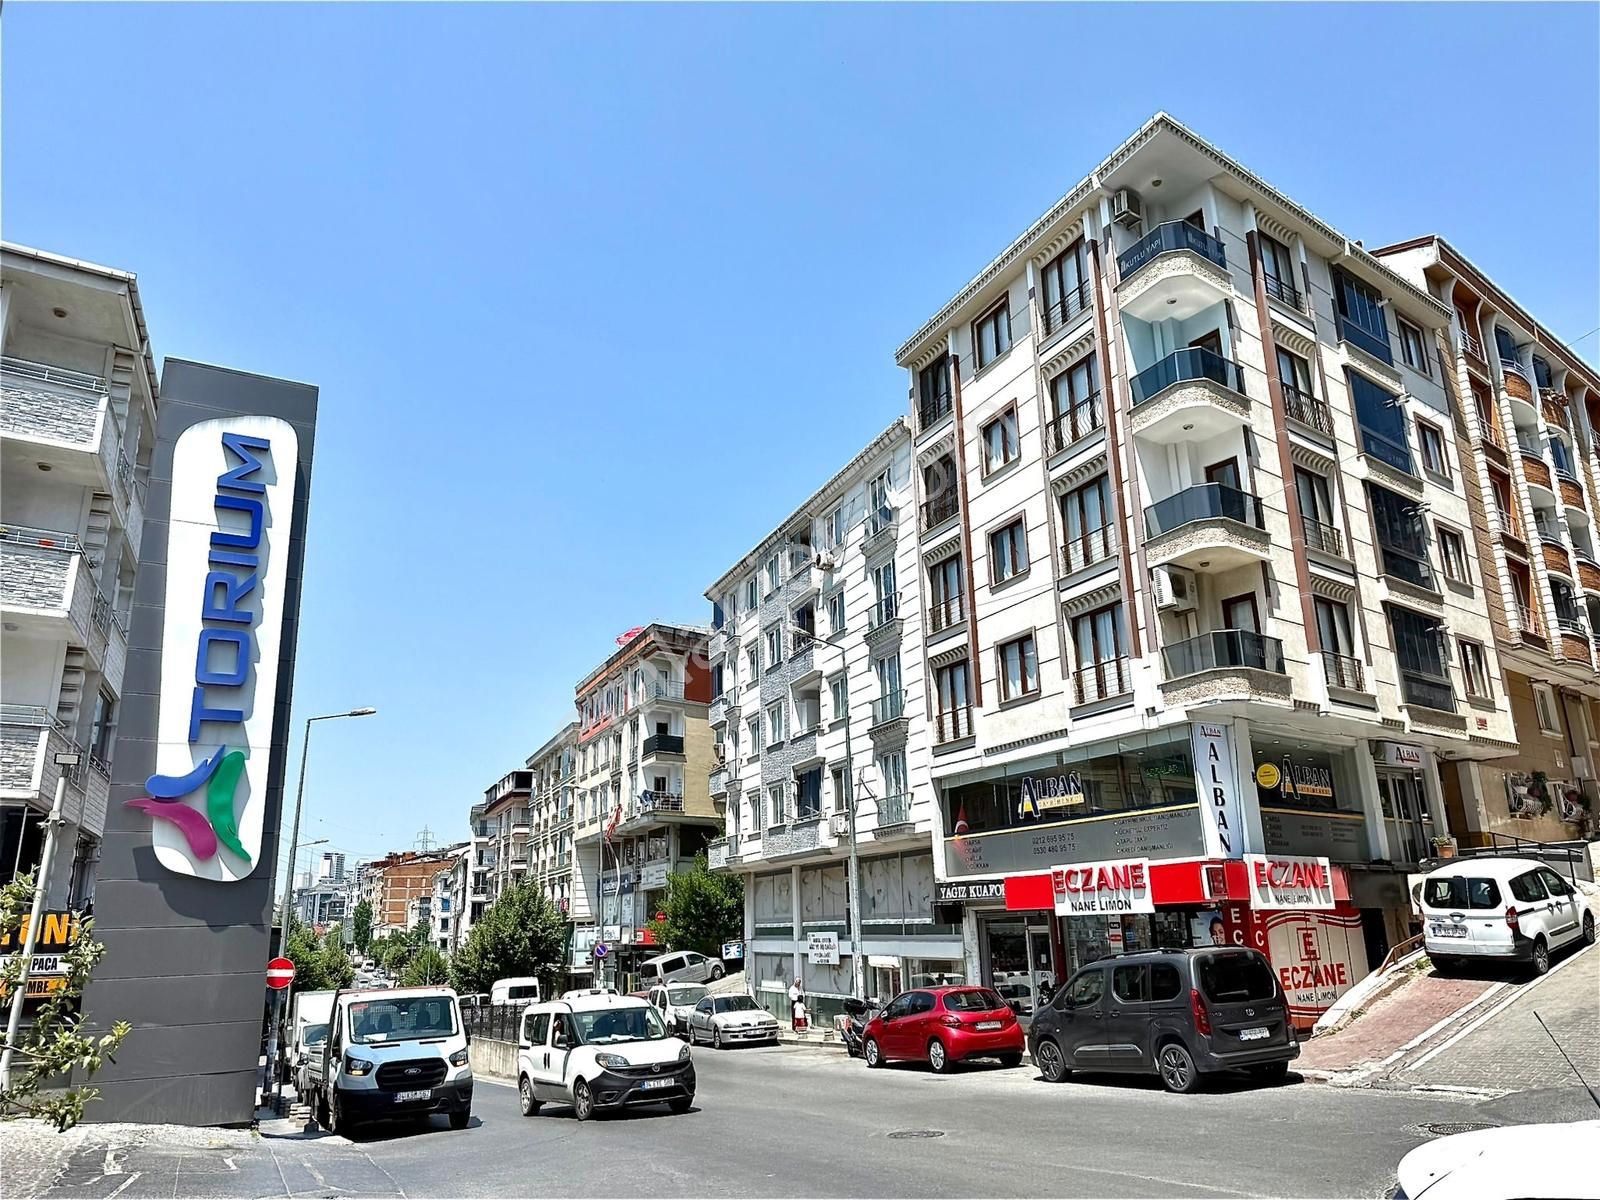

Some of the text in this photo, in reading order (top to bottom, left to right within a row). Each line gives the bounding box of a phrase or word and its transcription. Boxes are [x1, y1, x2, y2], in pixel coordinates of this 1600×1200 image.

[188, 432, 271, 743] TORIUM
[1396, 747, 1420, 763] ALBAN
[1281, 759, 1330, 801] ALBAN
[1018, 774, 1083, 820] ALBAN
[1209, 742, 1231, 853] ALBAN
[1054, 861, 1147, 894] ECZANE
[1256, 860, 1331, 892] ECZANE
[1071, 900, 1097, 913] NANE
[1280, 963, 1347, 991] ECZANE
[1297, 993, 1315, 1003] NANE
